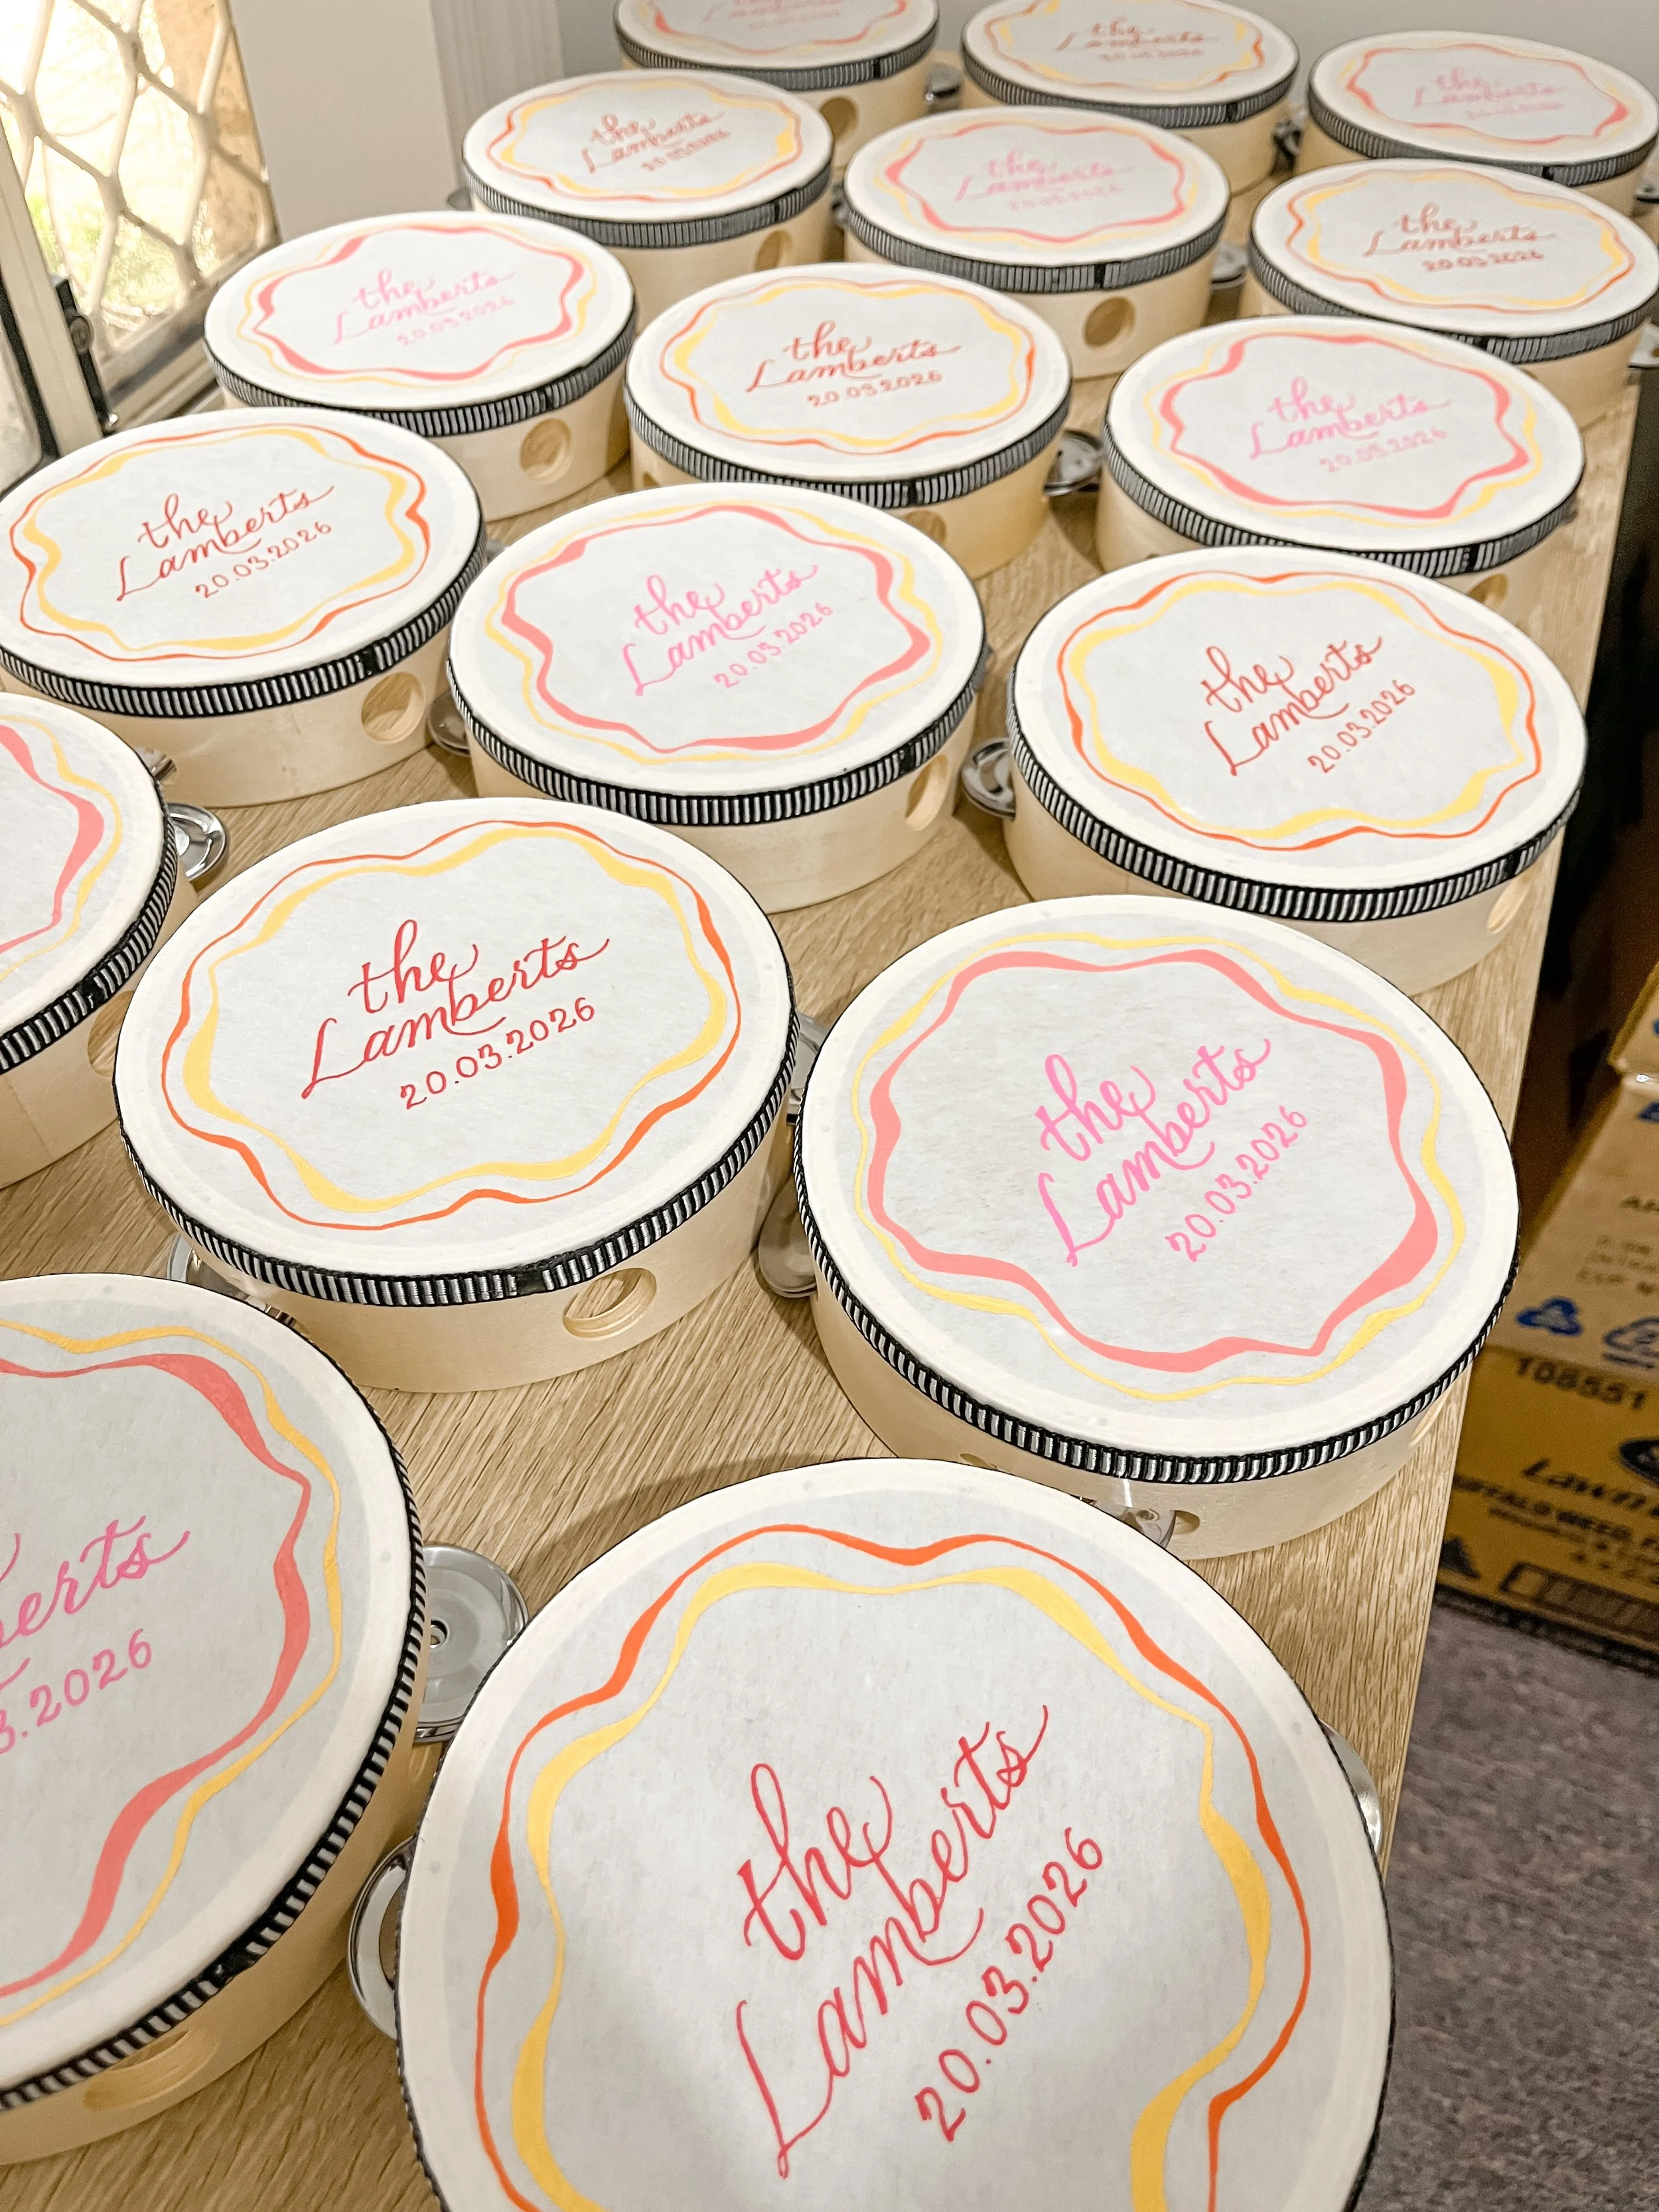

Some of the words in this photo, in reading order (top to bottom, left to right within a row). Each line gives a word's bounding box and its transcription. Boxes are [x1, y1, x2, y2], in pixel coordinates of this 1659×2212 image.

[1390, 203, 1479, 234] the
[334, 271, 517, 344] Lamberts
[352, 267, 435, 309] the
[746, 340, 962, 392] Lamberts
[782, 320, 873, 360] the
[1250, 393, 1452, 459] Lamberts
[1267, 377, 1356, 423] the
[117, 484, 335, 601] Lamberts
[137, 493, 233, 549] the
[194, 521, 332, 598] 20.03.2026
[622, 564, 818, 697] Lamberts
[633, 573, 725, 635] the
[1200, 646, 1294, 713] the
[1204, 635, 1383, 776] Lamberts
[1307, 680, 1415, 773] 20.03.2026
[347, 919, 479, 1013] the
[301, 936, 610, 1099] Lamberts
[400, 997, 595, 1110] 20.03.2026
[1035, 1054, 1155, 1161] the
[1038, 1038, 1271, 1266] Lamberts
[1165, 1105, 1307, 1263] 20.03.2026
[0, 1515, 191, 1650] erts
[737, 1764, 893, 1960] the
[737, 1705, 1048, 2179] Lamberts
[914, 1827, 1104, 2142] 20.03.2026
